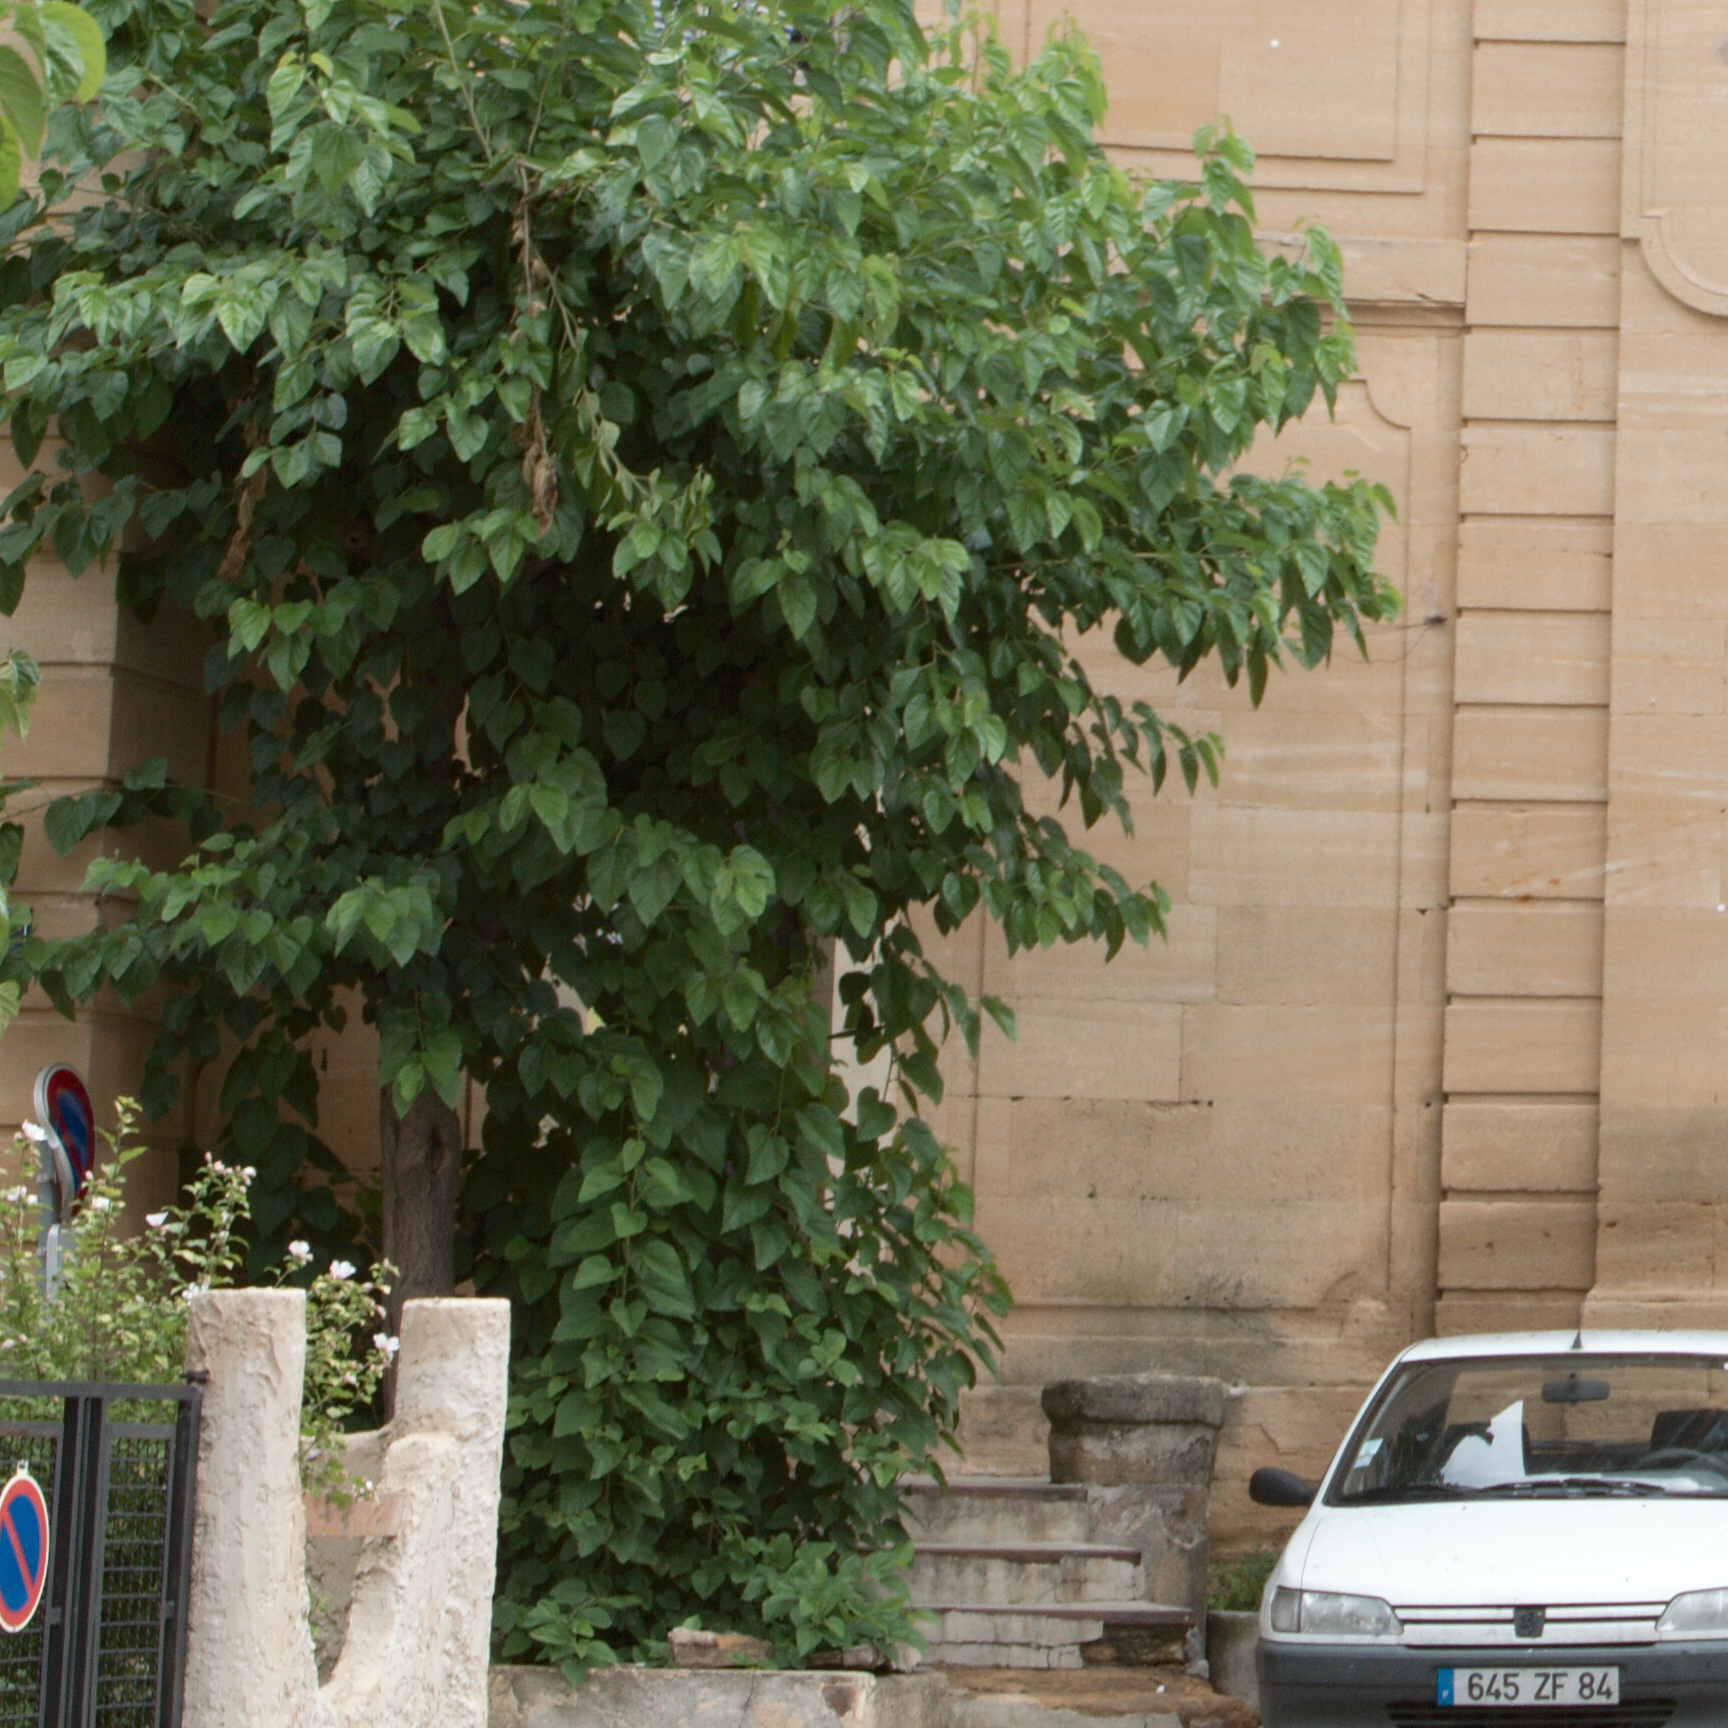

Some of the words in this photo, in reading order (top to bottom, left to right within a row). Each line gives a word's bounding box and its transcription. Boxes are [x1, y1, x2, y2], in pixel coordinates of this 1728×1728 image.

[1467, 1672, 1521, 1702] 645
[1533, 1672, 1569, 1701] ZF
[1578, 1671, 1613, 1701] 84
